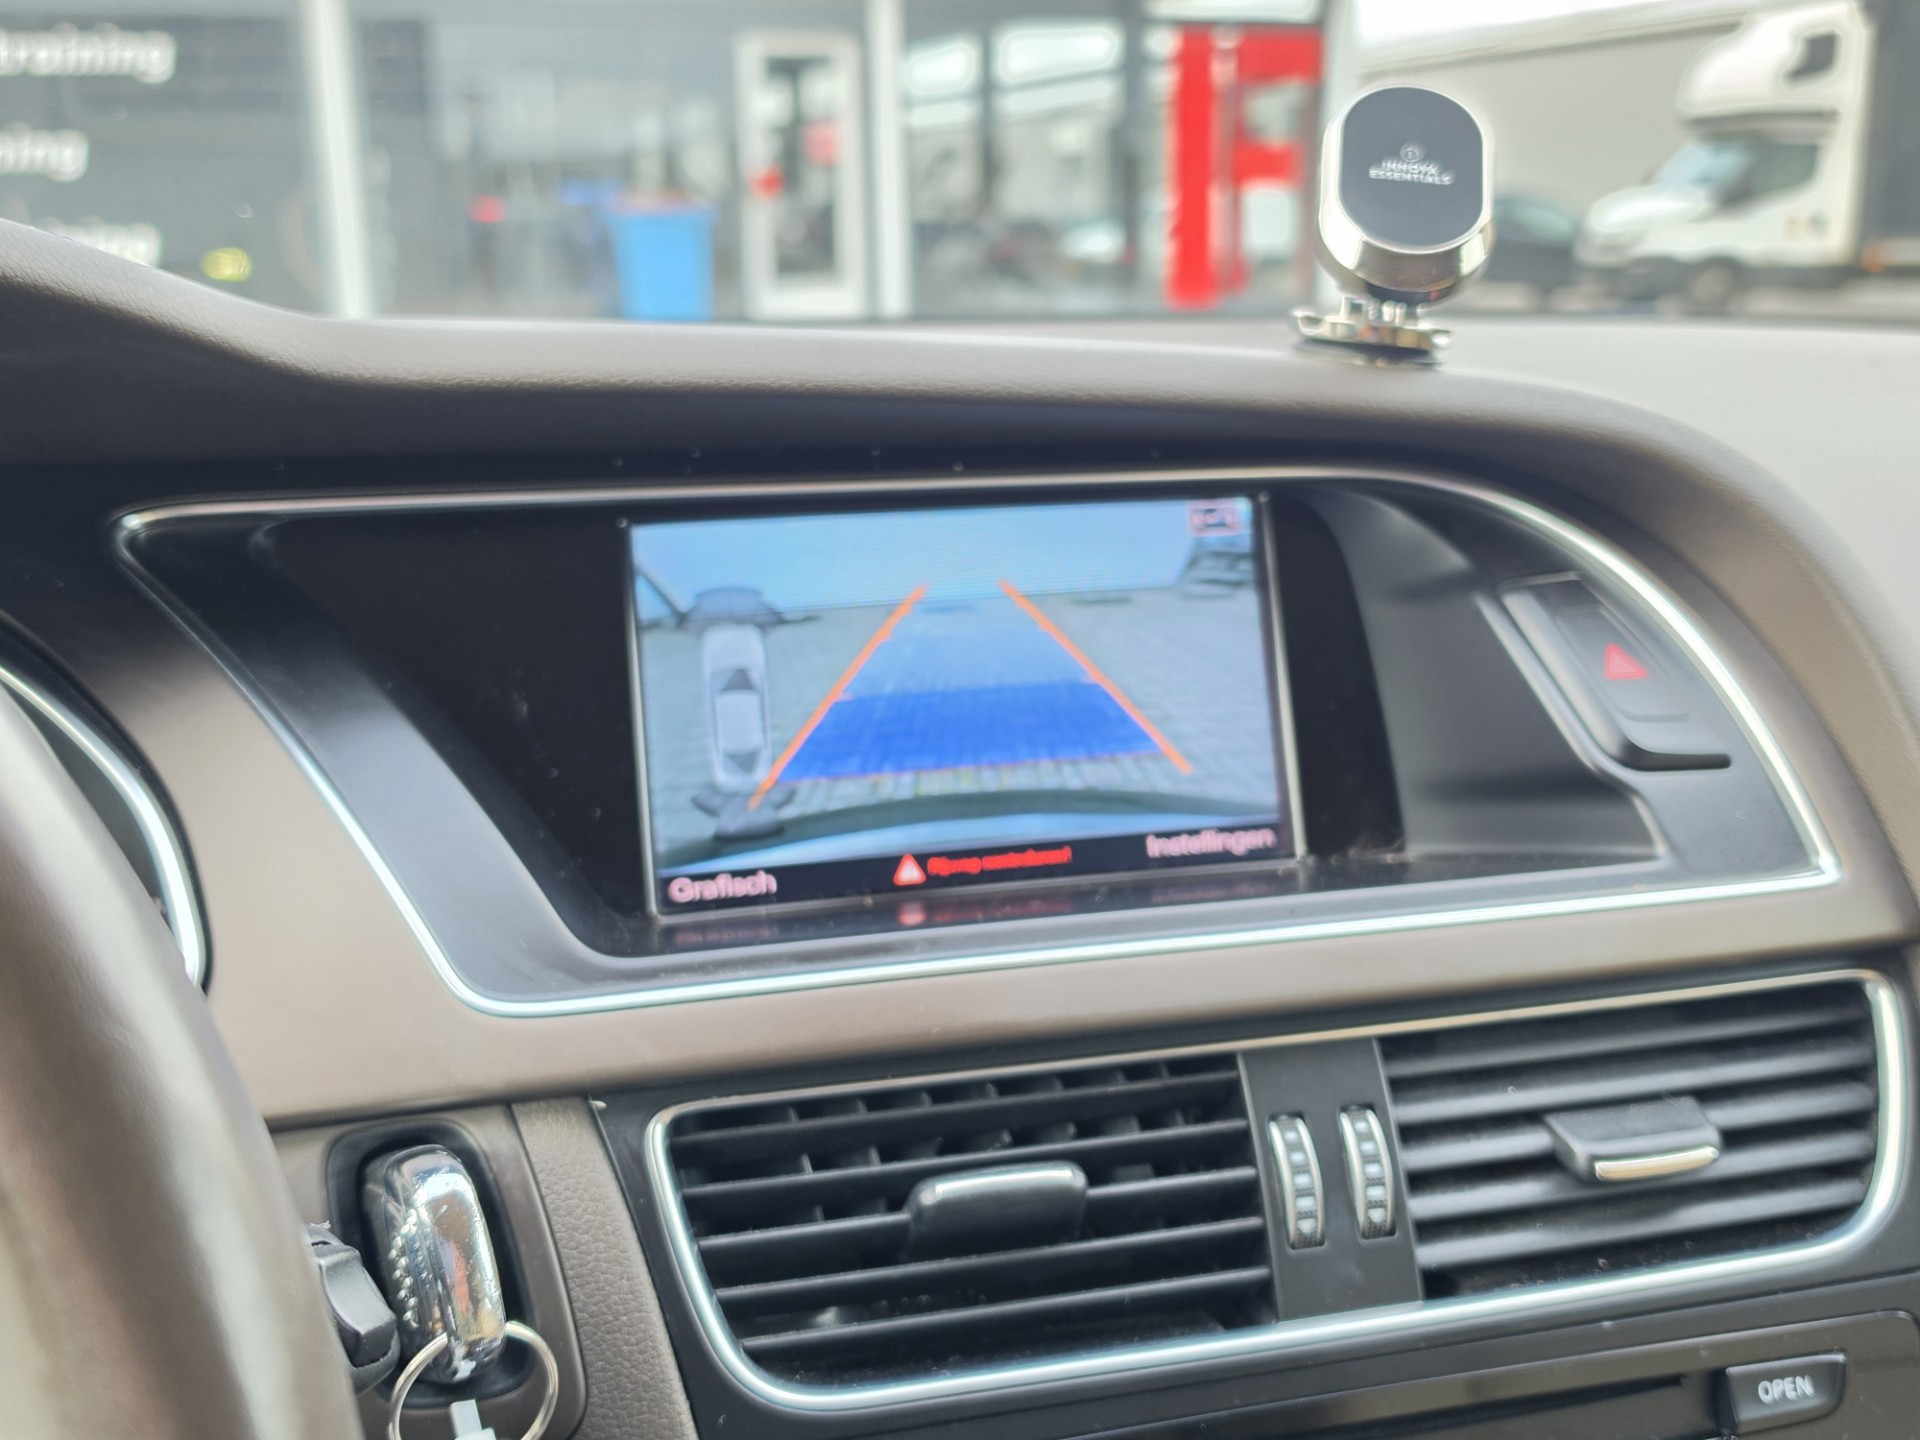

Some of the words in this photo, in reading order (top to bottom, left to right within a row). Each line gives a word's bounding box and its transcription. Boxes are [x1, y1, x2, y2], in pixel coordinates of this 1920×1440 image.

[1368, 168, 1453, 185] ESSENTIALS
[1146, 829, 1277, 858] Instellingen
[667, 870, 777, 903] Grafisch
[1758, 1375, 1814, 1404] OPEN
